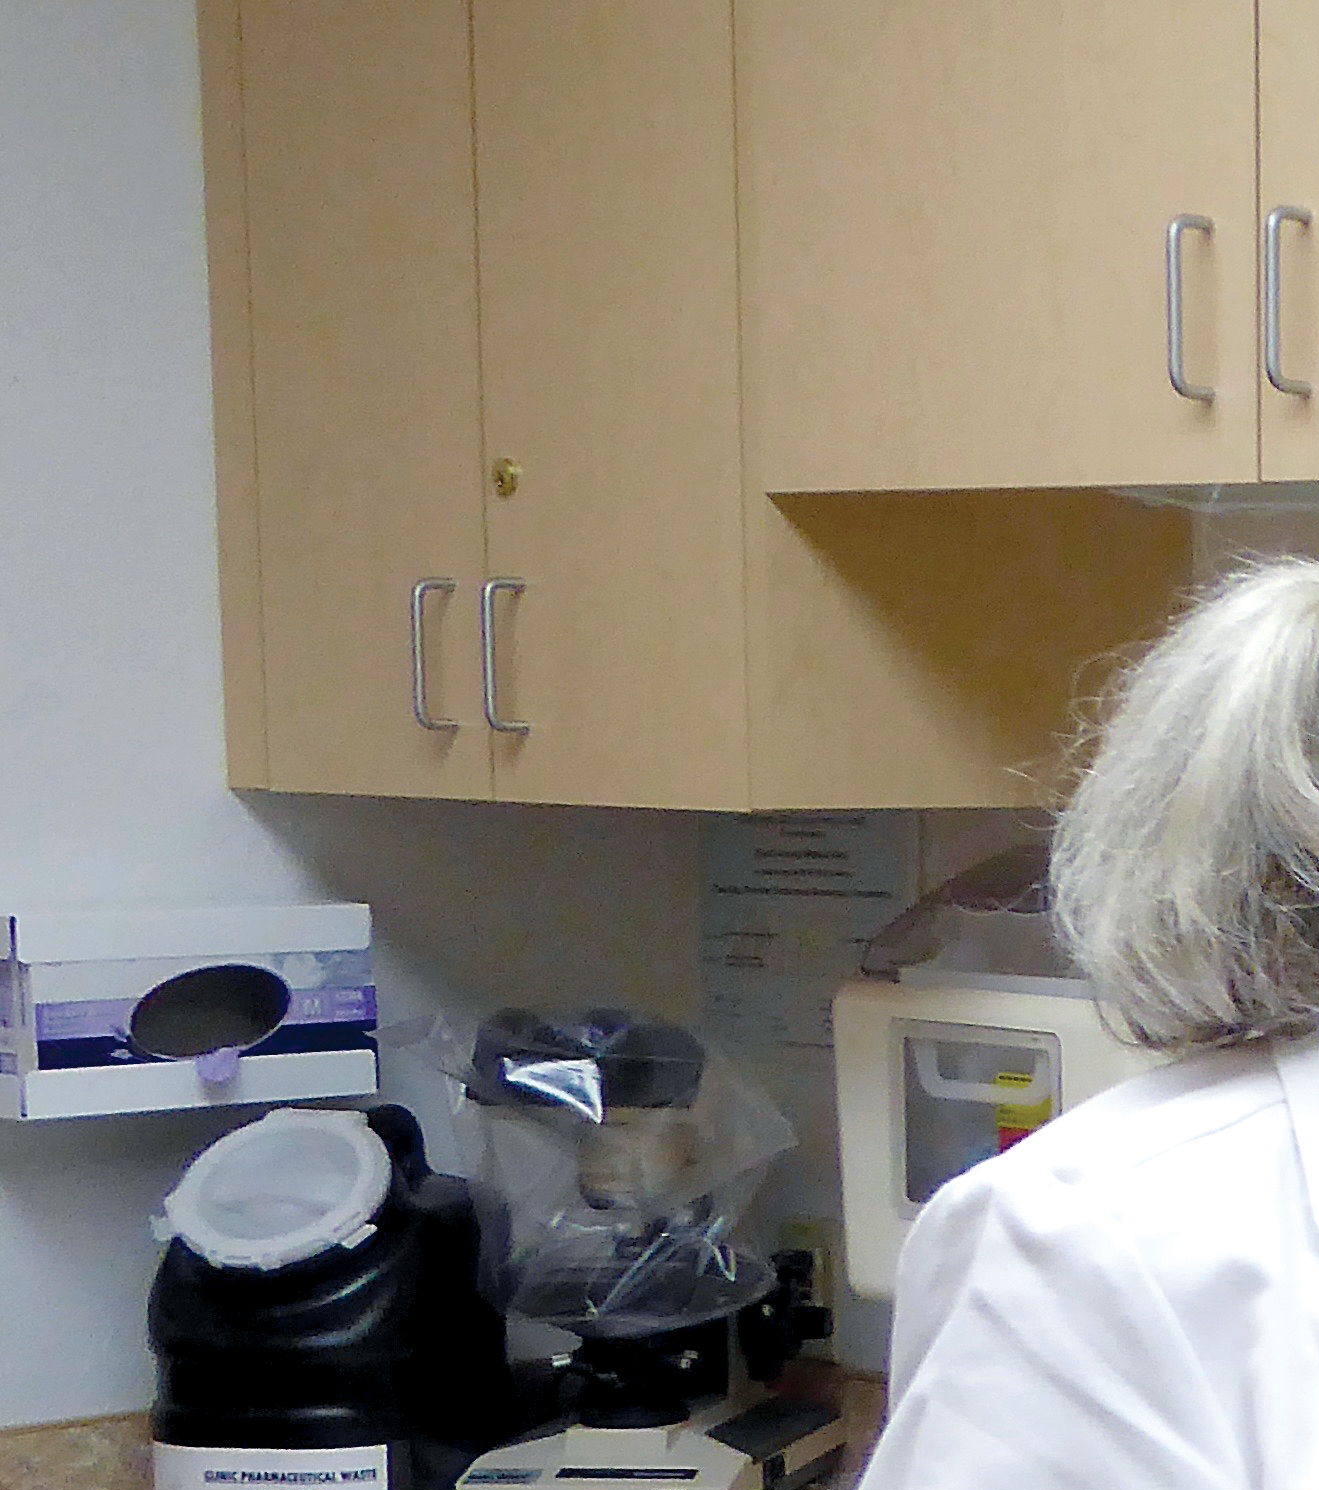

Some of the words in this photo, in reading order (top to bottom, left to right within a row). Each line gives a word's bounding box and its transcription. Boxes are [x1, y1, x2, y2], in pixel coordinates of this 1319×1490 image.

[204, 1469, 237, 1483] CLINIC
[241, 1470, 335, 1483] PHARMACEUTICAL
[340, 1468, 377, 1482] WASTE
